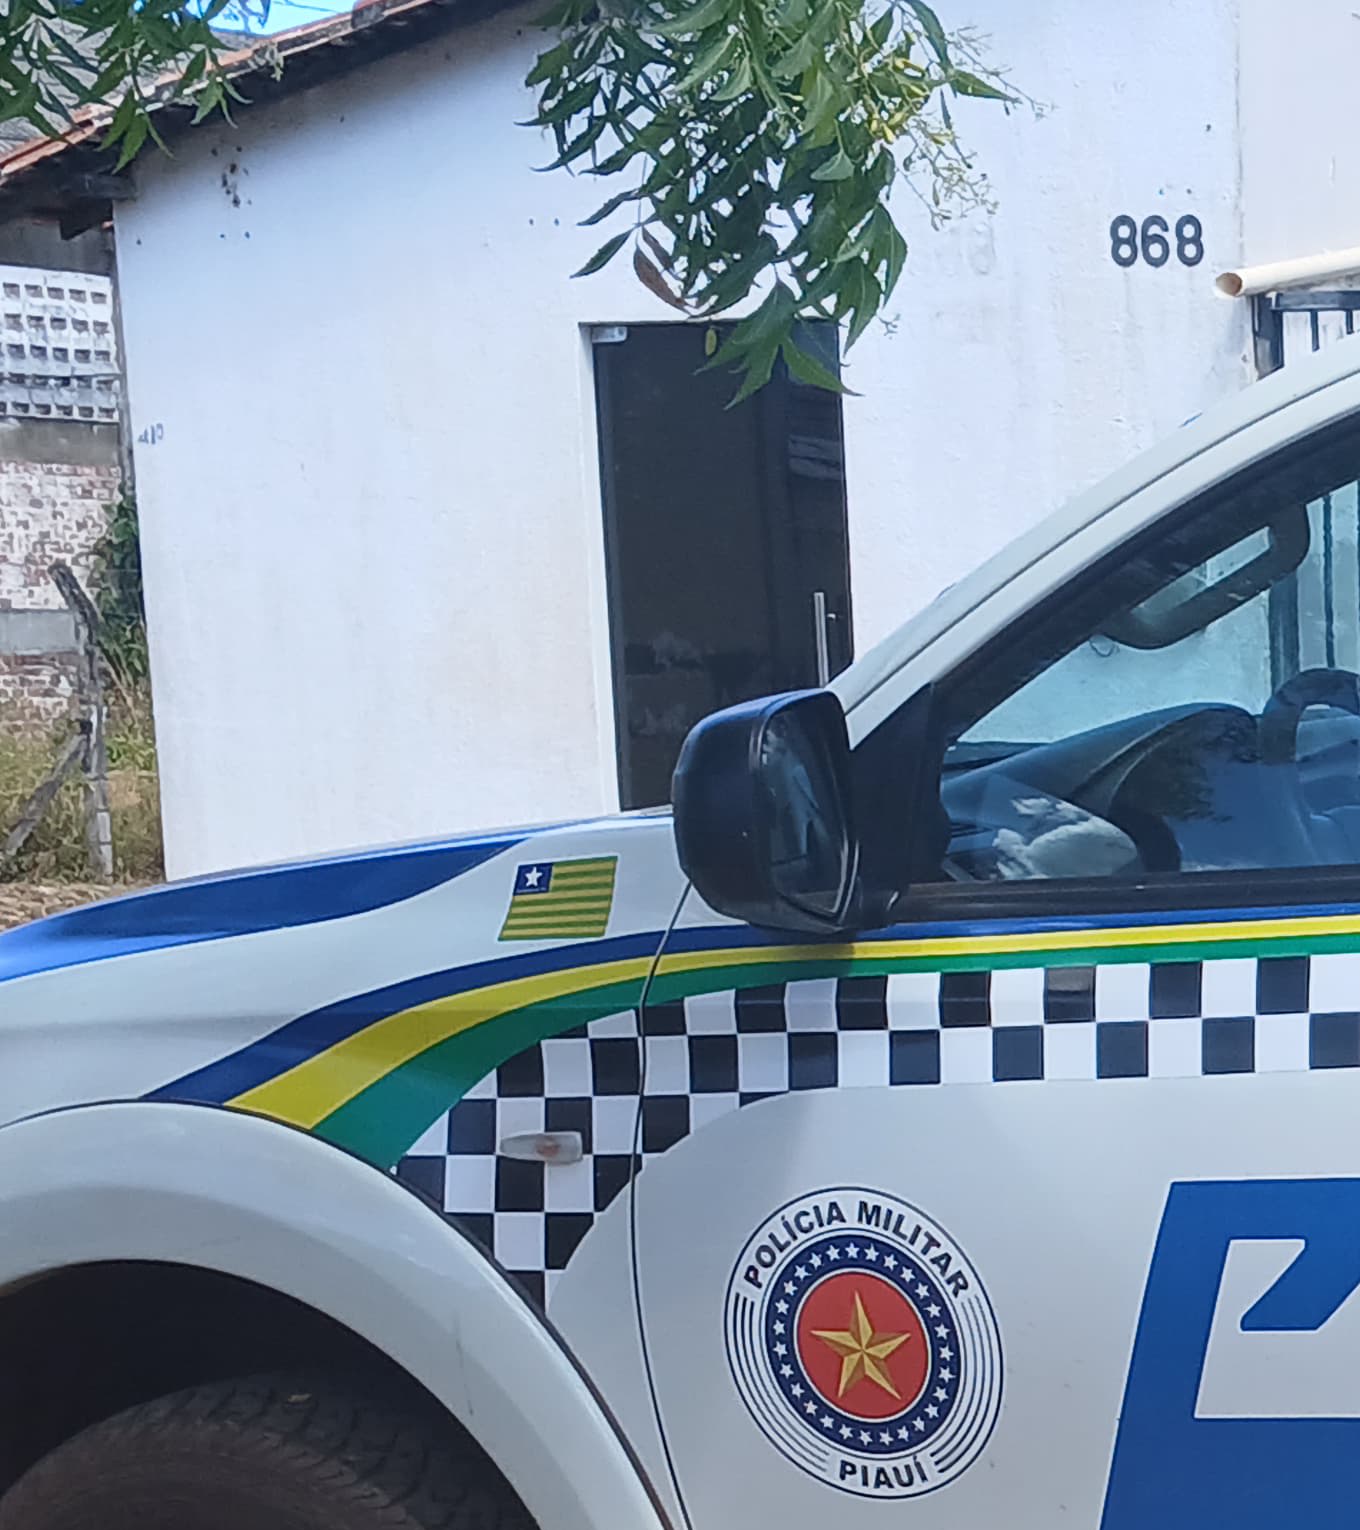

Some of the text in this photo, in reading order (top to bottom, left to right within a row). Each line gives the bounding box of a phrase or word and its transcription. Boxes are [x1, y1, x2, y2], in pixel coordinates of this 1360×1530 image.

[1109, 214, 1204, 268] 868
[744, 1200, 970, 1299] POLÍCIA MILITAR
[838, 1456, 928, 1490] PIAUÍ
